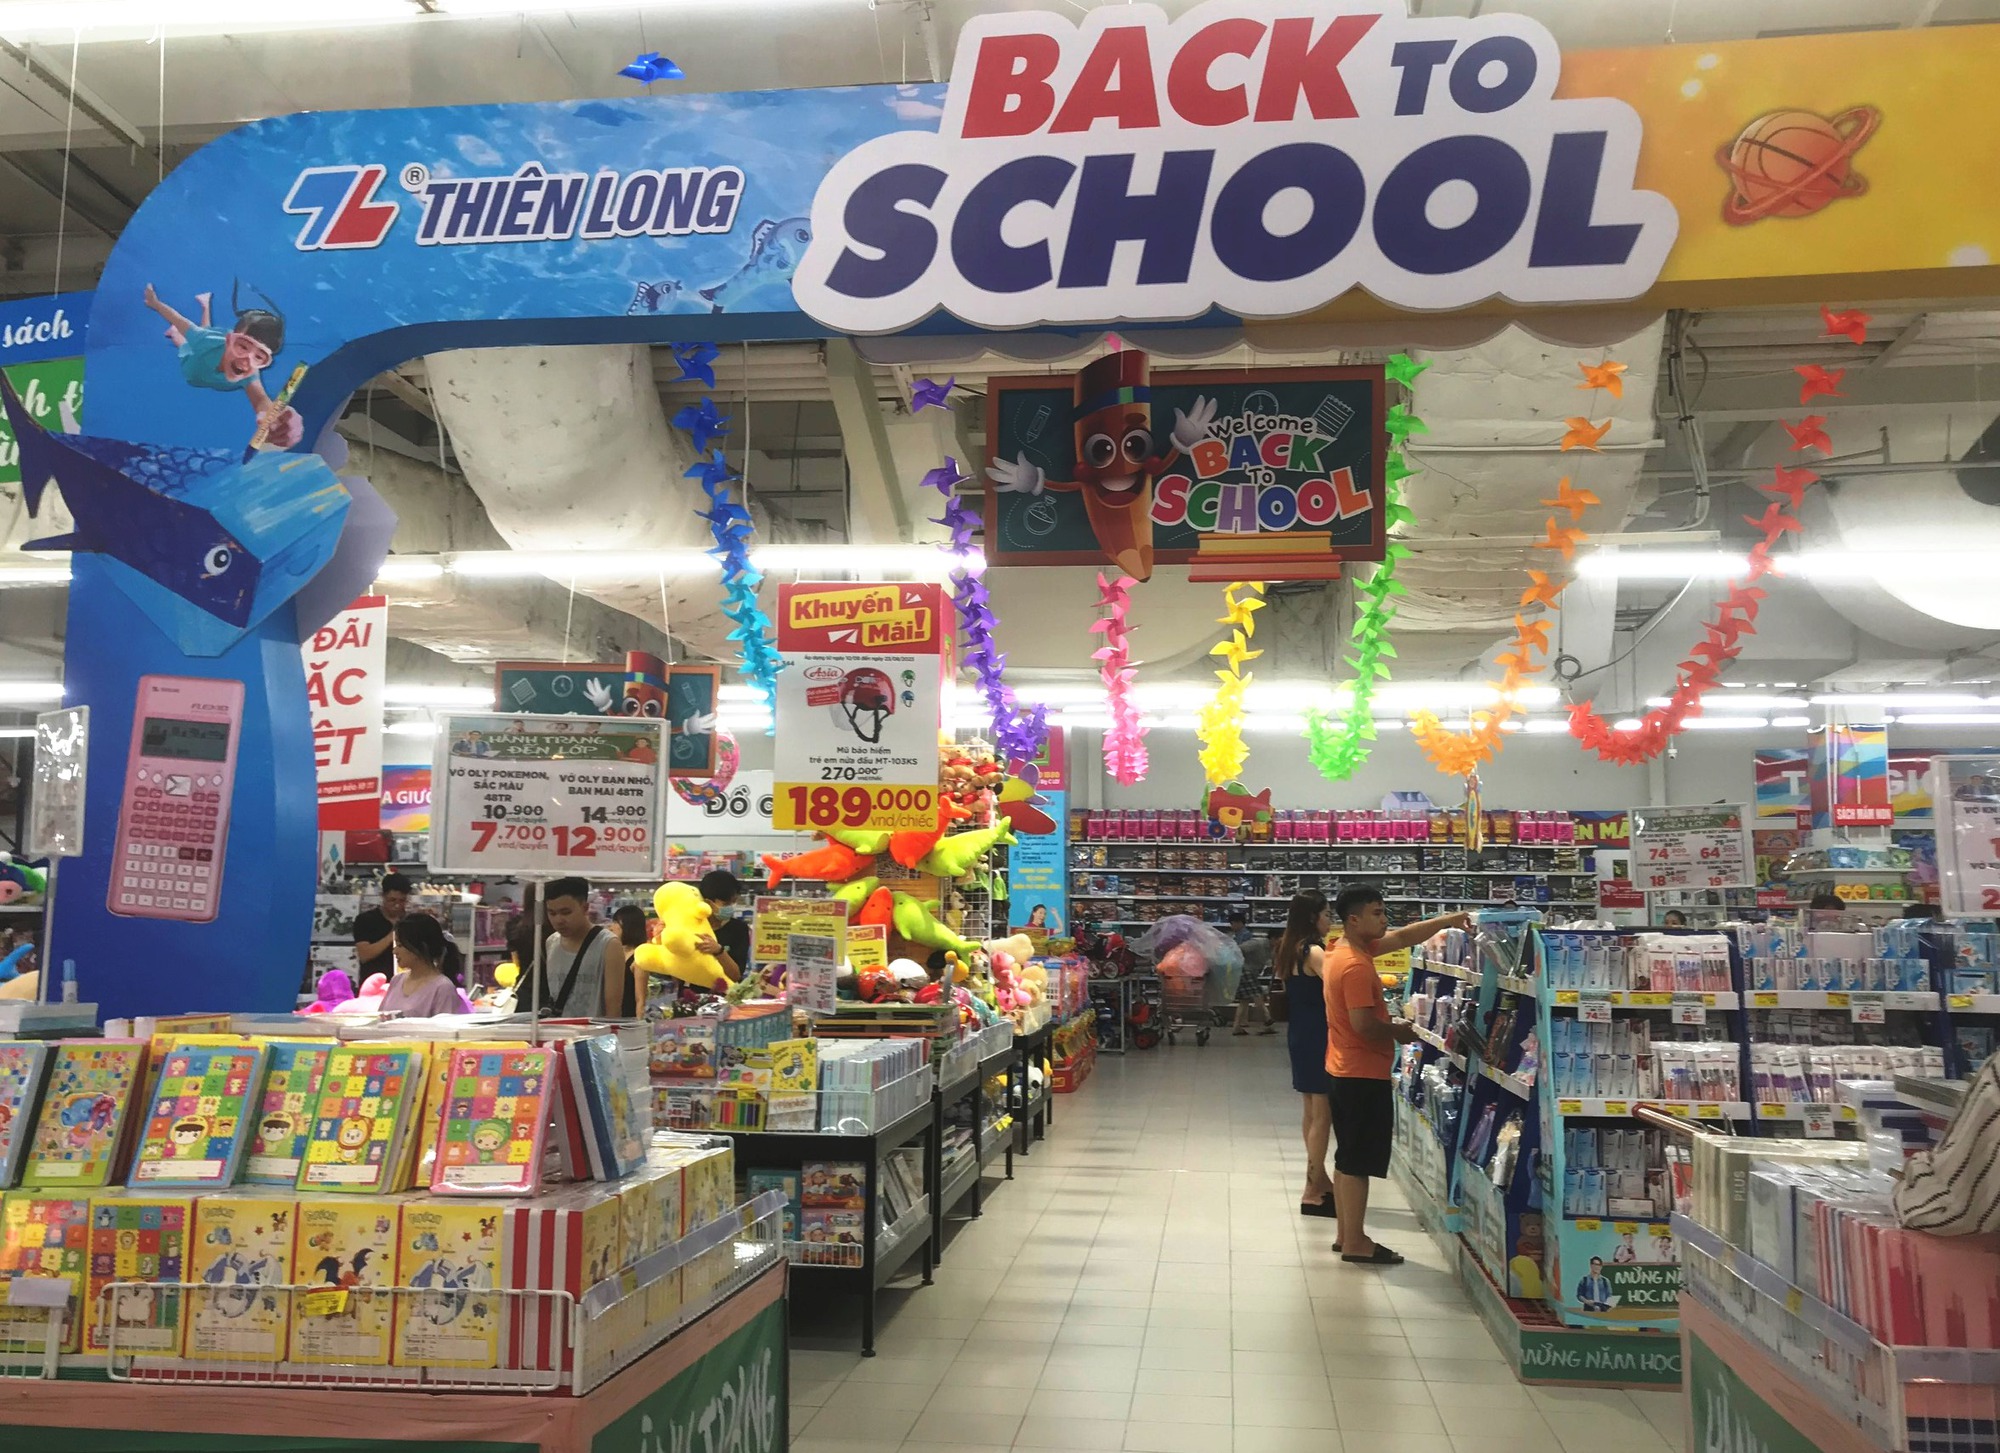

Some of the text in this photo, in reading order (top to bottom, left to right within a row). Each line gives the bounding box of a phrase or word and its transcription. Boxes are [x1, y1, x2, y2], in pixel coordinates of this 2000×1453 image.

[961, 14, 1538, 139] BACK TO
[422, 166, 739, 239] THIÊN LONG
[825, 130, 1645, 299] SCHOOL
[2, 309, 74, 348] sách
[1206, 411, 1317, 437] Welcome
[1191, 433, 1336, 479] BACK
[1248, 467, 1277, 487] To
[1148, 467, 1373, 533] SCHOOL
[794, 592, 893, 620] Khuyến
[313, 617, 373, 652] ĐÃI
[868, 609, 926, 643] Mãi!
[809, 667, 838, 678] Asia
[809, 756, 822, 764] trẻ
[856, 756, 873, 765] đầu
[836, 746, 891, 755] Mũ bảo hiểm
[468, 769, 489, 778] OLY
[491, 769, 550, 780] POKEMON,
[578, 775, 599, 784] OLY
[871, 814, 934, 827] vnd/chiếc
[1735, 1170, 1746, 1201] PLUS
[1585, 1346, 1636, 1370] NĂM
